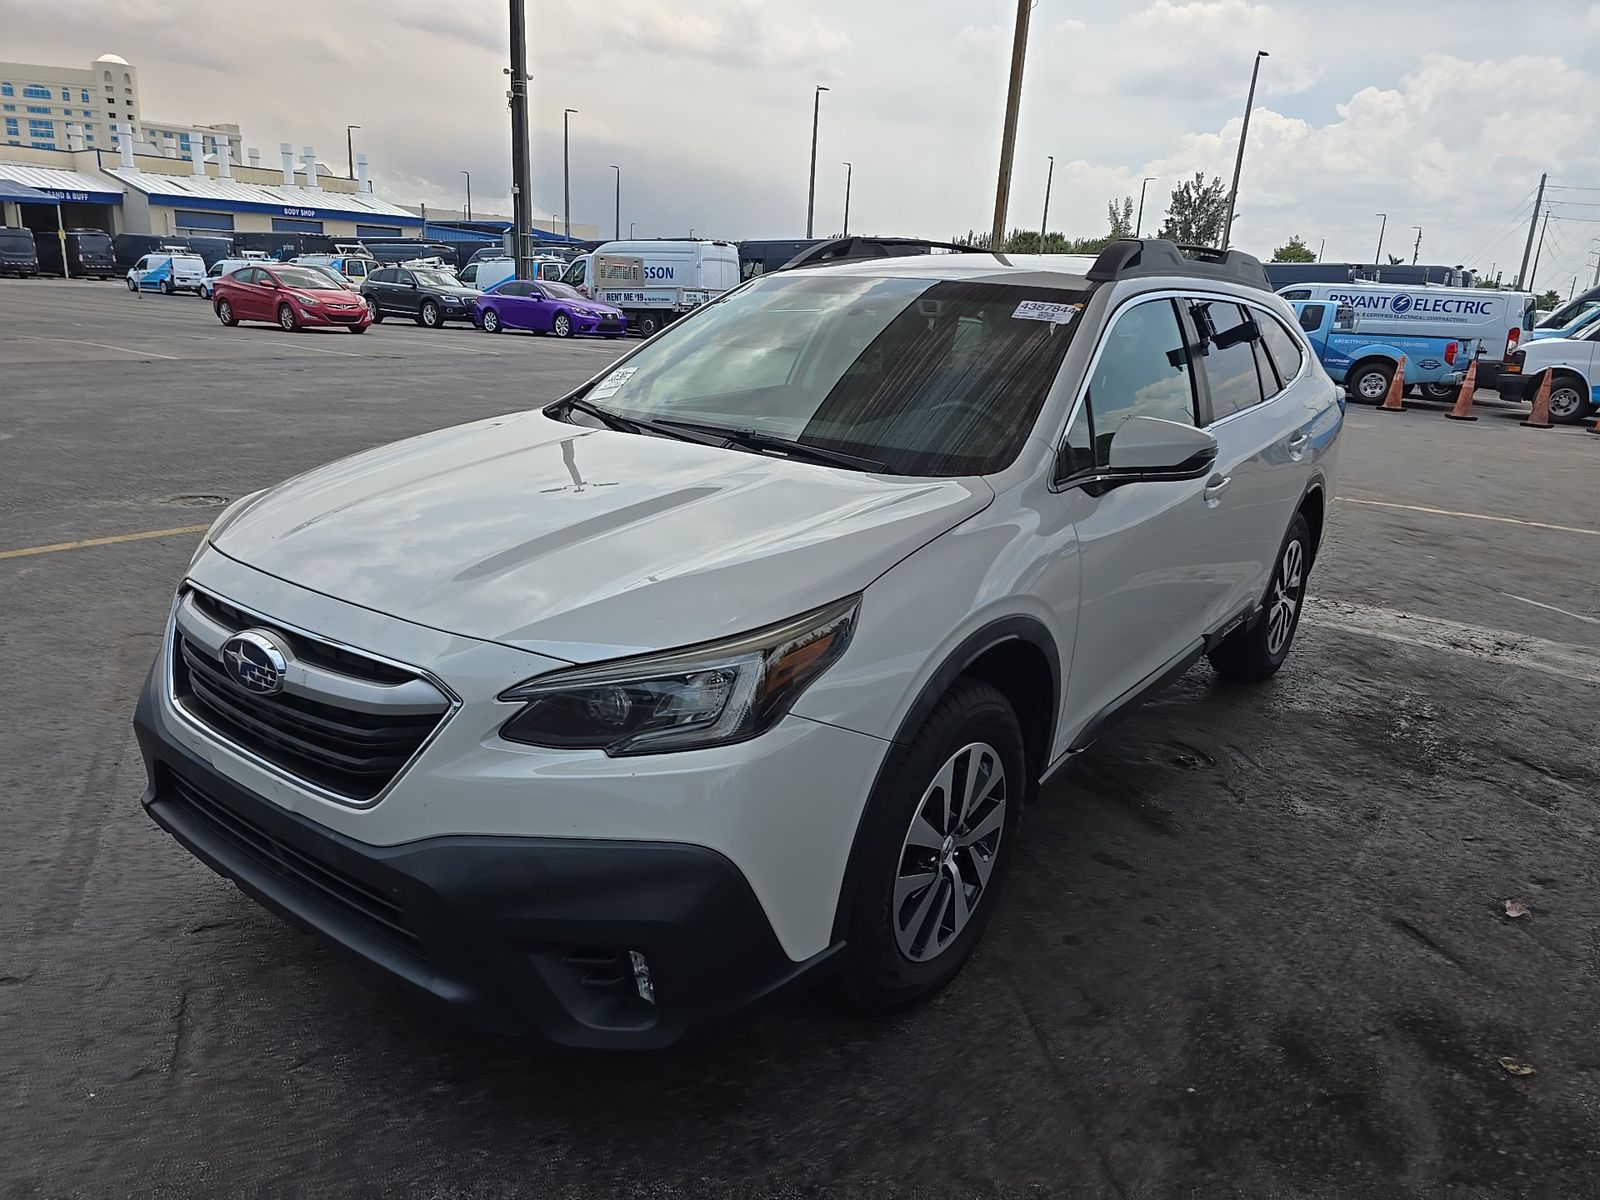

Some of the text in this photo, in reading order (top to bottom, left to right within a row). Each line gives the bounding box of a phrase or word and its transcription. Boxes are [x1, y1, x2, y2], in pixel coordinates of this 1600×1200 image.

[72, 192, 89, 200] BUFF
[284, 208, 315, 217] BODY SHOP
[606, 292, 623, 301] RENT
[623, 292, 634, 301] ME
[1020, 303, 1076, 315] 4387844
[1413, 298, 1493, 315] ELECTRIC
